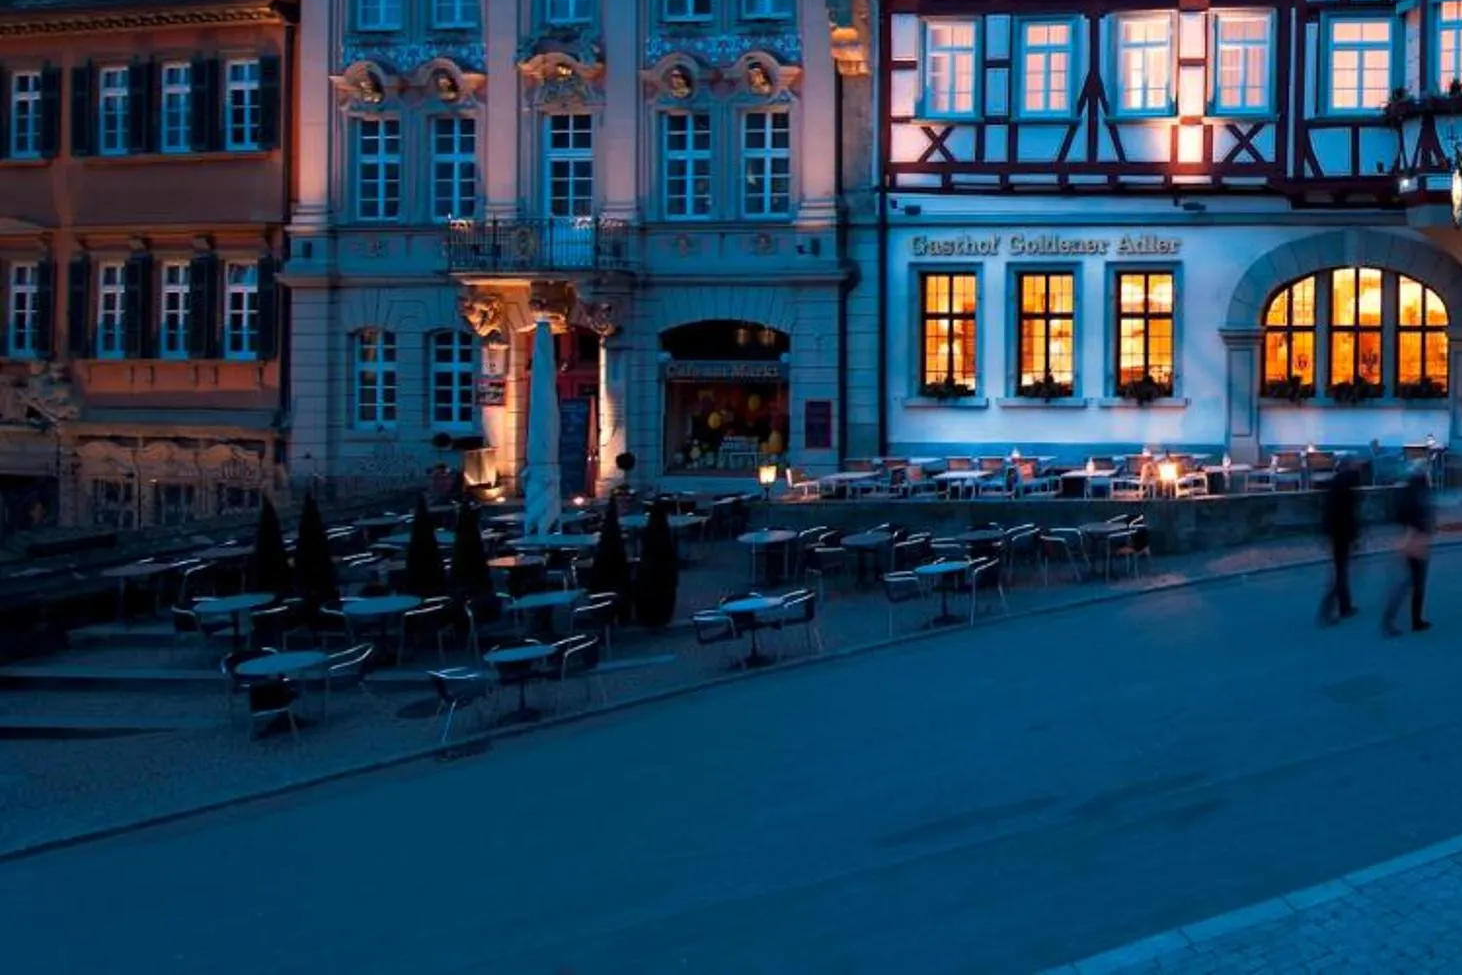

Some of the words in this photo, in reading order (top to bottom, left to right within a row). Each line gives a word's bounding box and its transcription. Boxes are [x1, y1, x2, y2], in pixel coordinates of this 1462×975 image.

[909, 234, 1001, 256] Gasthof
[1008, 233, 1110, 256] Goldener
[1117, 233, 1182, 255] Adler
